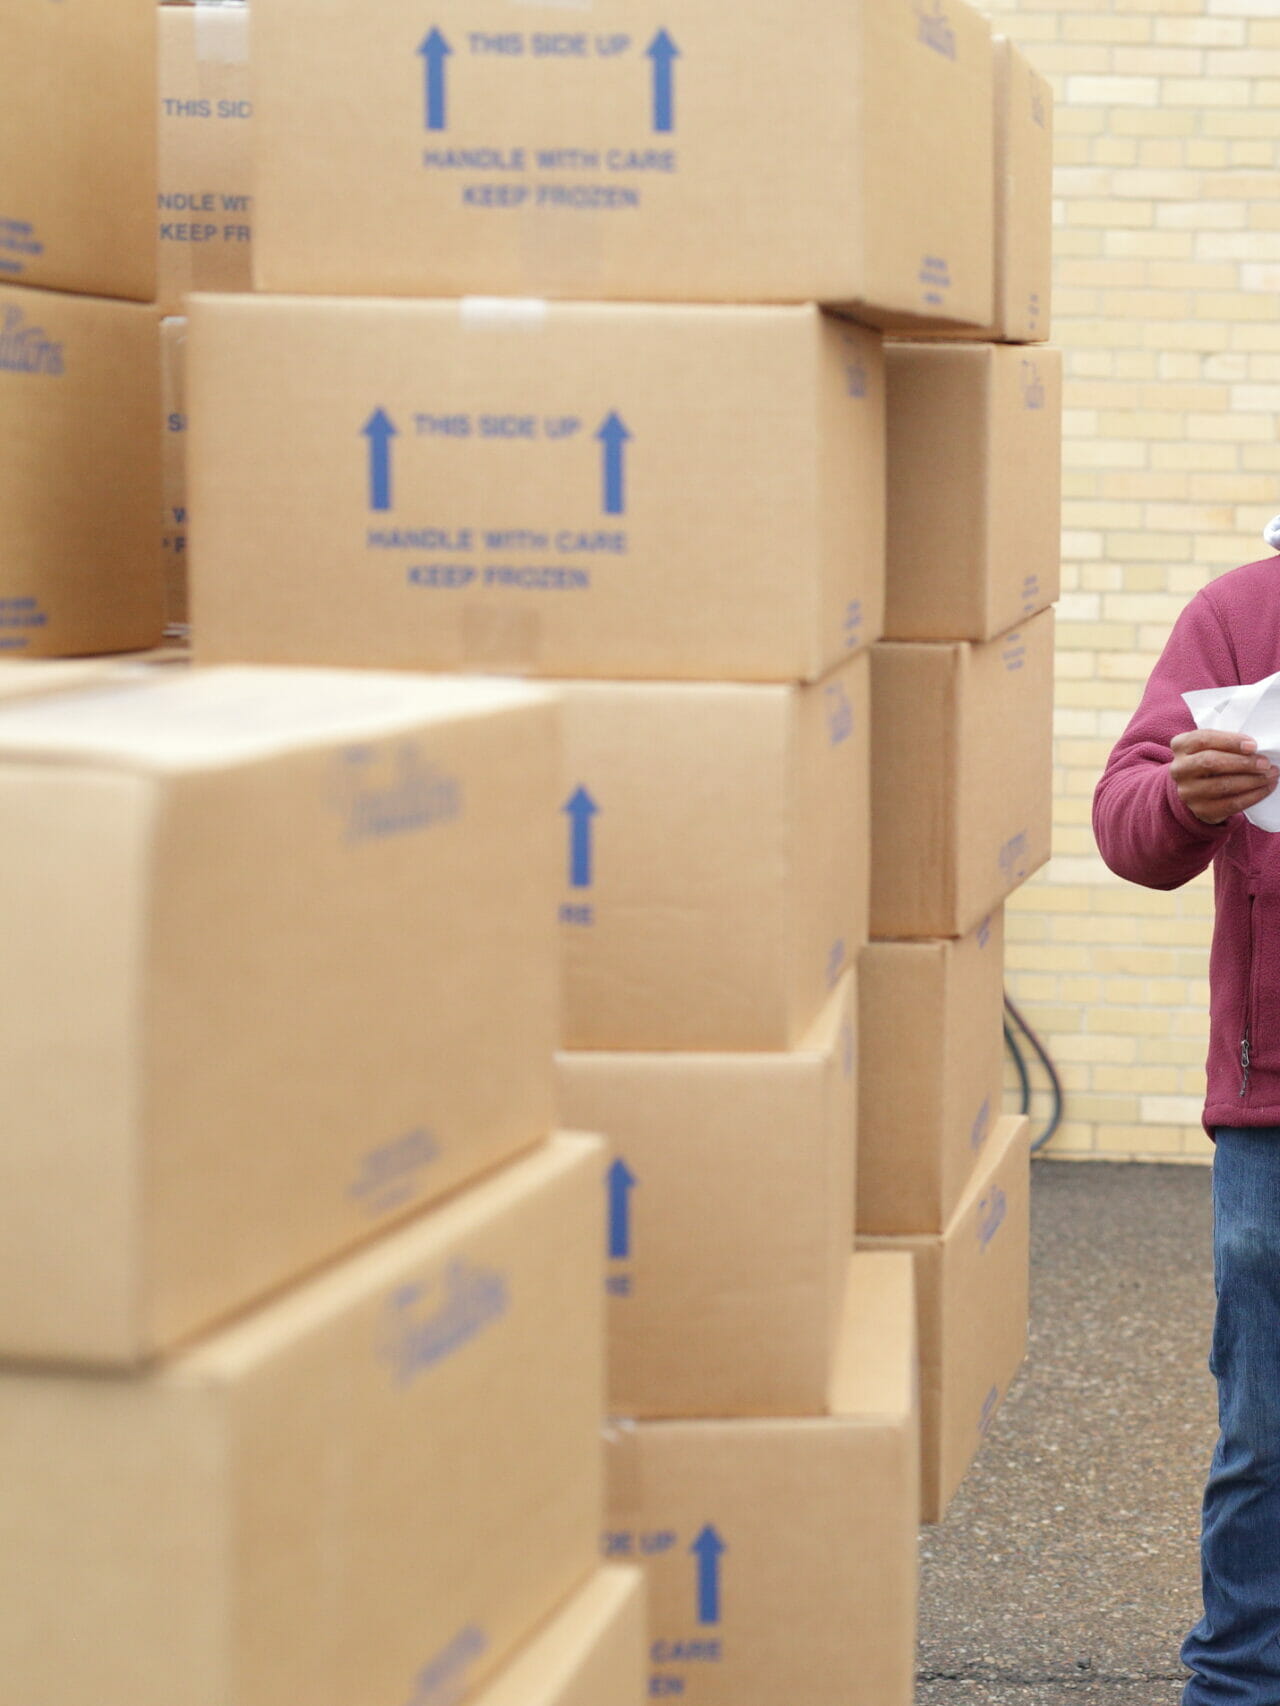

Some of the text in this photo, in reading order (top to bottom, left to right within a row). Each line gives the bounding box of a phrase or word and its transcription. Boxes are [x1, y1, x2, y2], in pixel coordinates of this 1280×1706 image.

[469, 32, 631, 56] THIS SIDE UP
[163, 98, 211, 118] THIS
[423, 149, 676, 173] HANDLE WITH CARE
[463, 184, 640, 209] KEEP FROZEN
[159, 223, 217, 242] KEEP
[414, 412, 581, 439] THIS SIDE UP
[367, 528, 627, 554] HANDLE WITH CARE
[407, 565, 590, 589] KEEP FROZEN
[639, 1529, 677, 1554] UP
